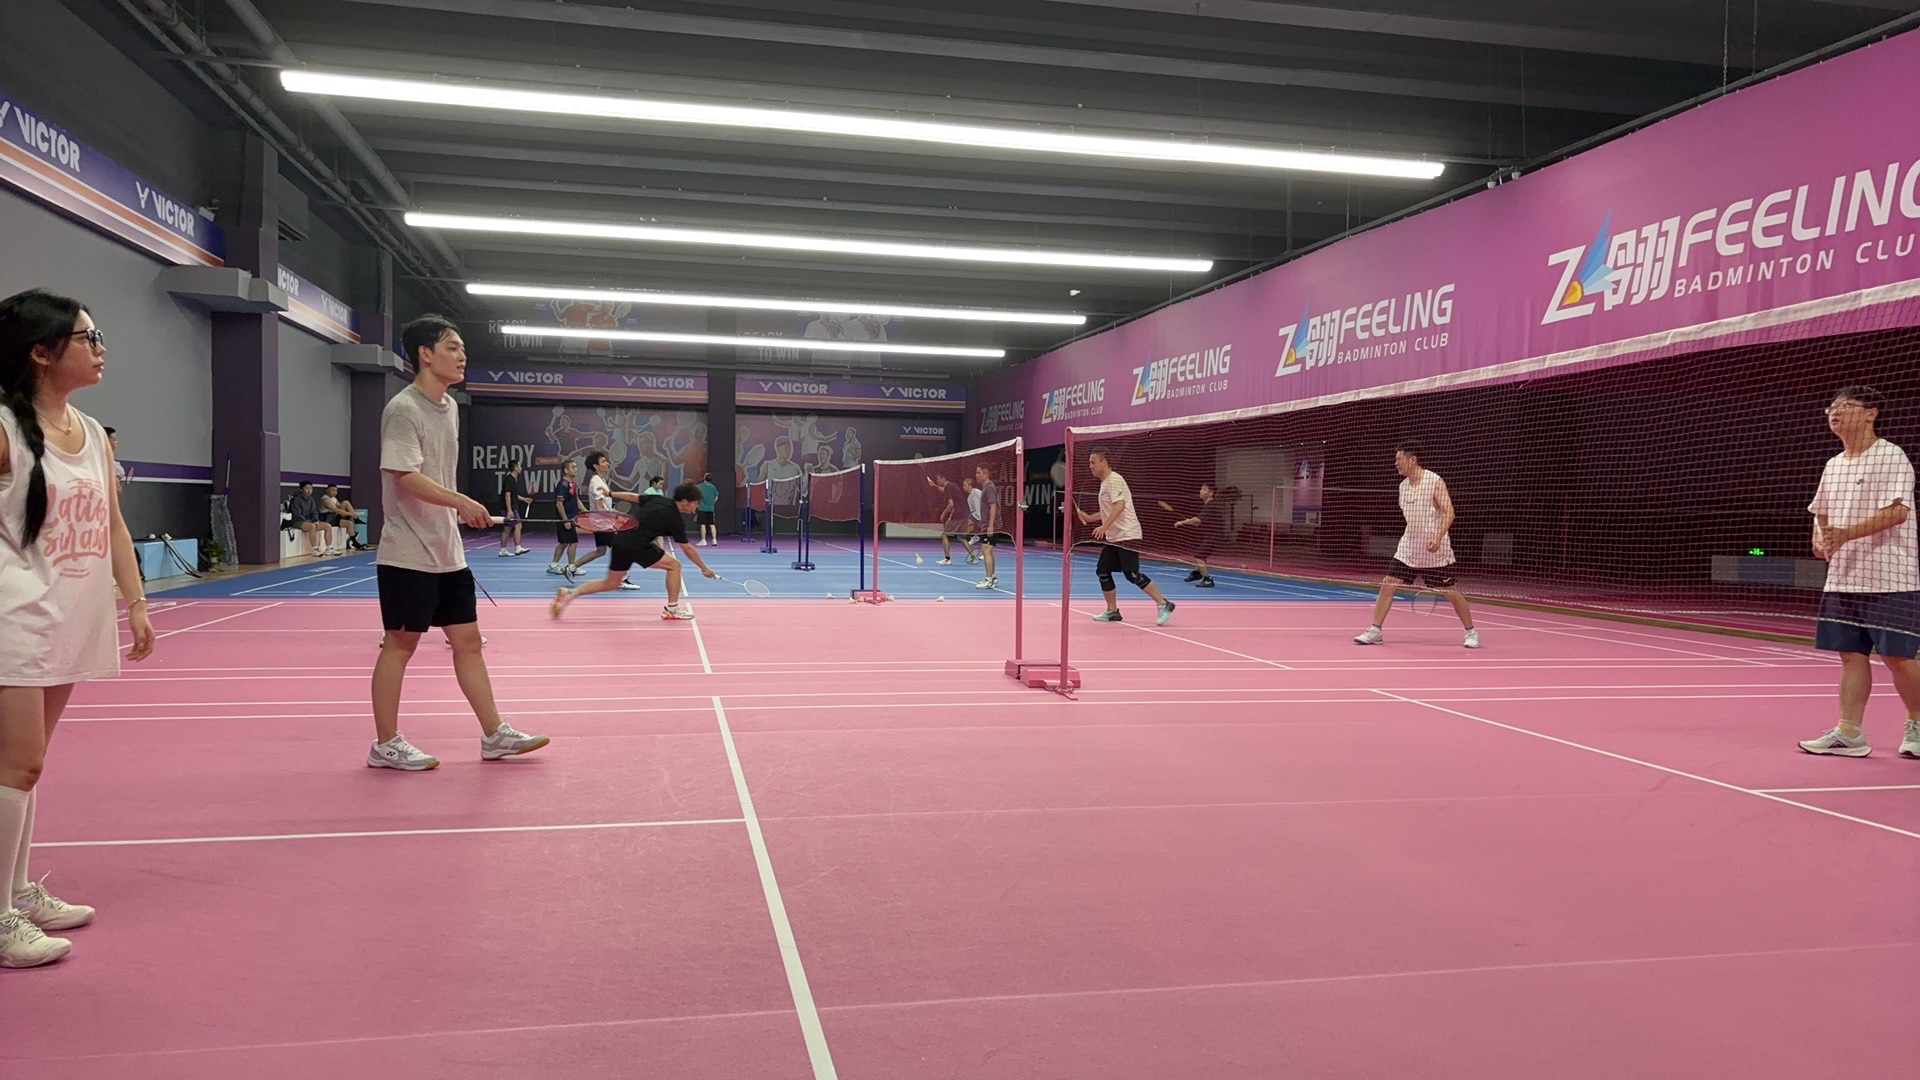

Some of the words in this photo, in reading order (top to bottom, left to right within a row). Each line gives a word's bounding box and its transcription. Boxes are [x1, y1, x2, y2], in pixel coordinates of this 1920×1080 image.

[14, 106, 80, 173] VICTOR
[151, 190, 195, 237] VICTOR
[277, 267, 299, 296] ICTOR
[1674, 248, 1835, 298] BADMINTON
[1340, 283, 1455, 344] FEELING
[502, 334, 516, 348] TO
[520, 334, 542, 348] WIN
[1337, 340, 1407, 364] BADMINTON
[1414, 332, 1449, 351] CLUB
[1168, 344, 1232, 384] FEELING
[507, 371, 563, 384] VICTOR
[641, 376, 695, 389] VICTOR
[776, 381, 828, 395] VICTOR
[1166, 383, 1206, 399] BADMINTON
[1209, 379, 1228, 392] CLUB
[897, 387, 946, 399] VICTOR
[1065, 378, 1105, 408] FEELING
[1091, 405, 1103, 416] CLUB
[913, 426, 944, 435] VICTOR
[473, 444, 535, 469] READY
